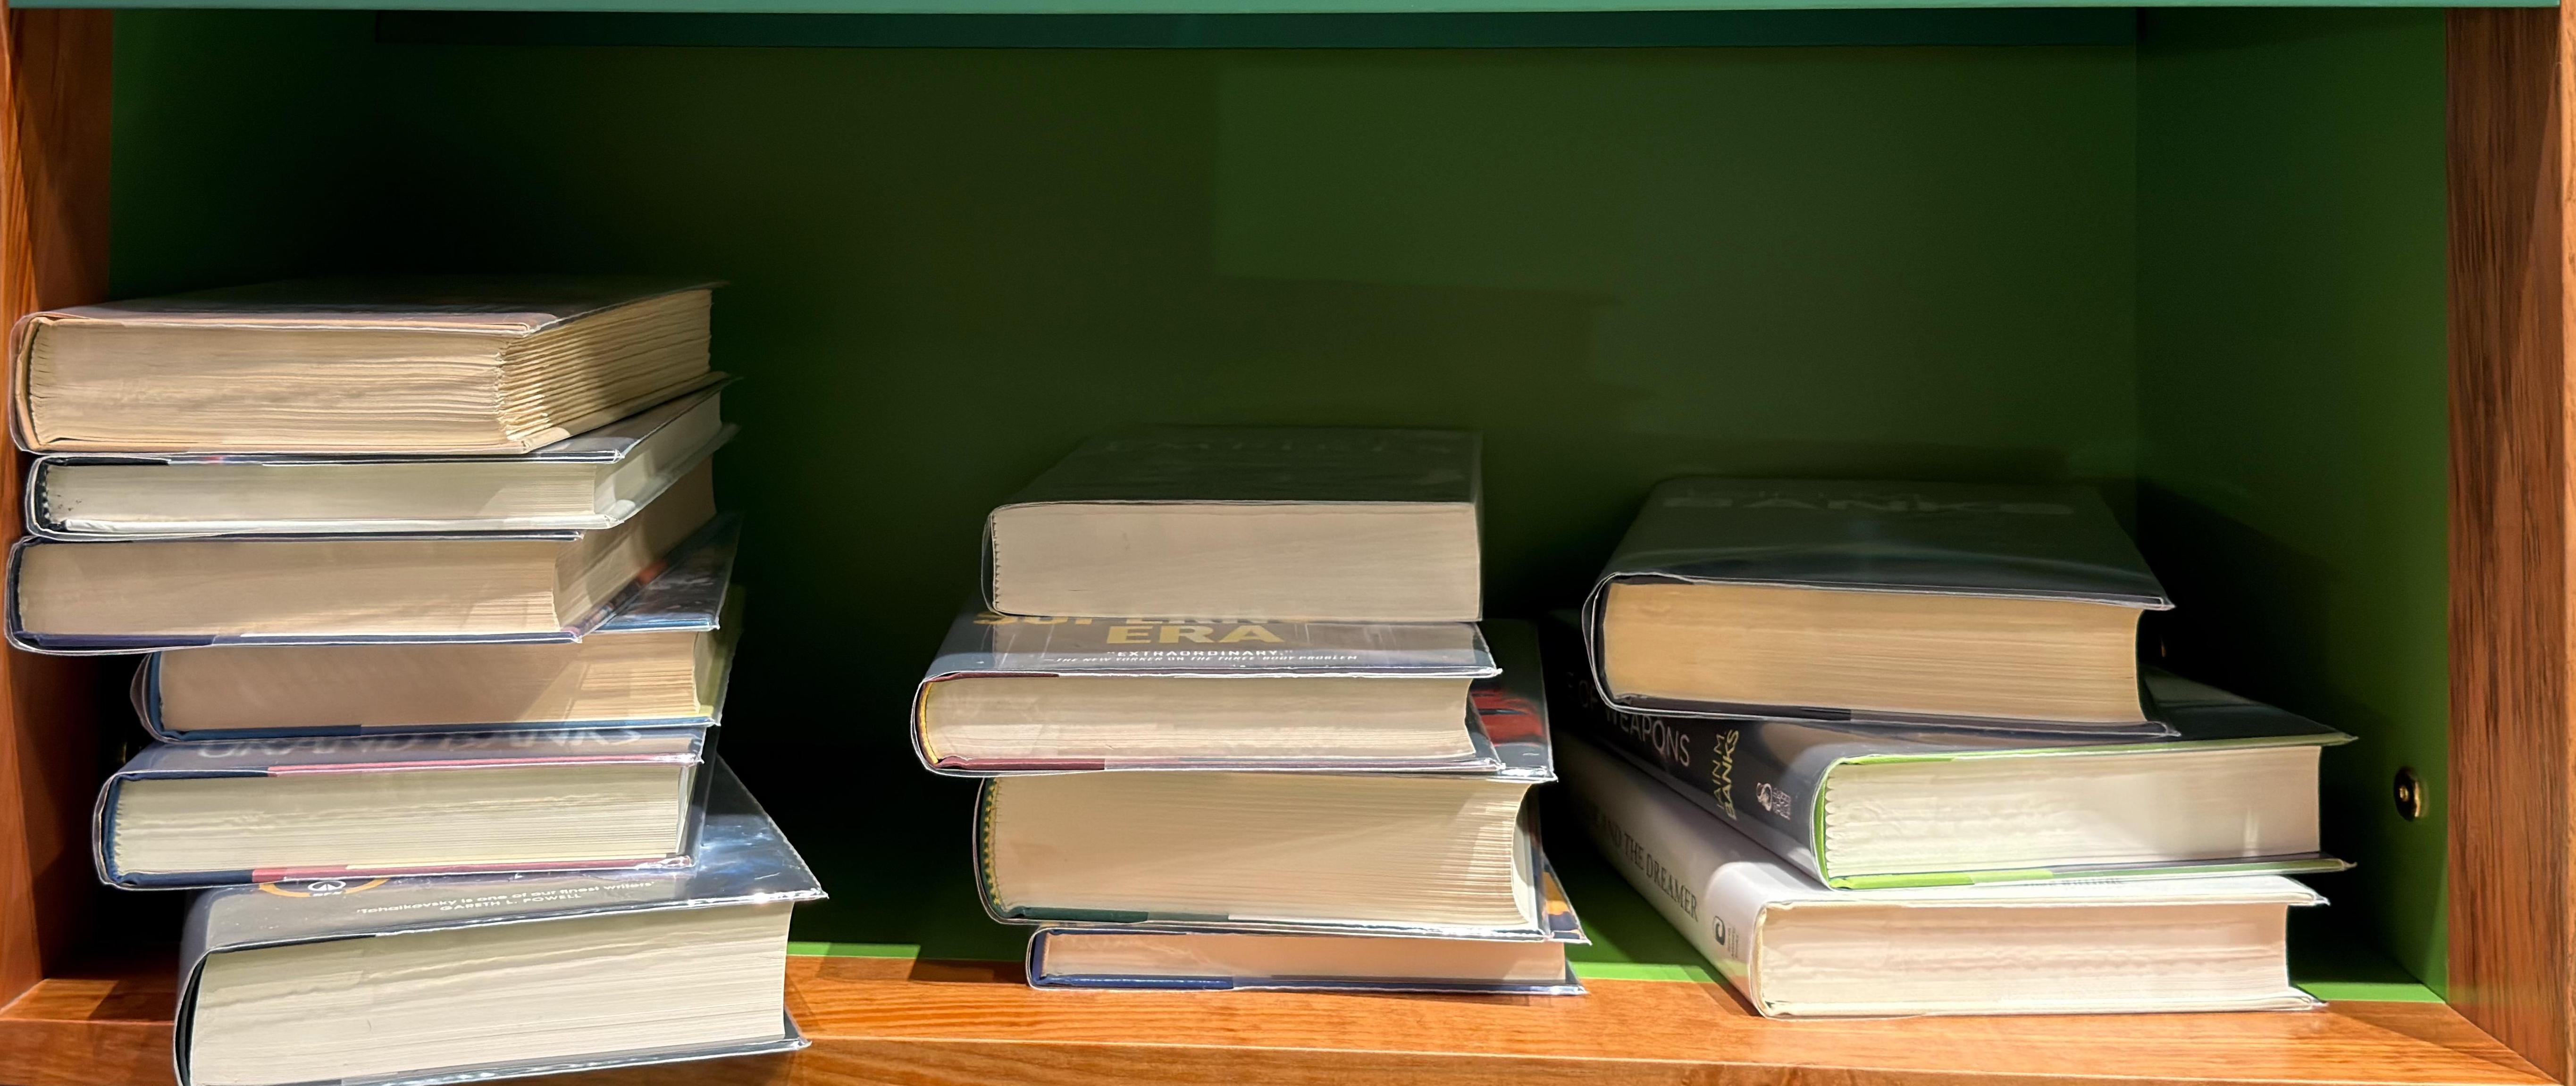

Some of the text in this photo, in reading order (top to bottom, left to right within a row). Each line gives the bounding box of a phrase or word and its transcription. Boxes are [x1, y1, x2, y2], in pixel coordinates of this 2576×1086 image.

[1107, 625, 1284, 643] ERA
[1605, 707, 1690, 768] WEAPONS
[1712, 760, 1725, 810] IAIN
[1722, 729, 1739, 821] BANKS
[440, 901, 500, 911] GARETH
[523, 894, 582, 903] POWELL
[560, 886, 600, 894] finest
[1624, 833, 1645, 870] THE
[1645, 853, 1698, 922] DREAMER
